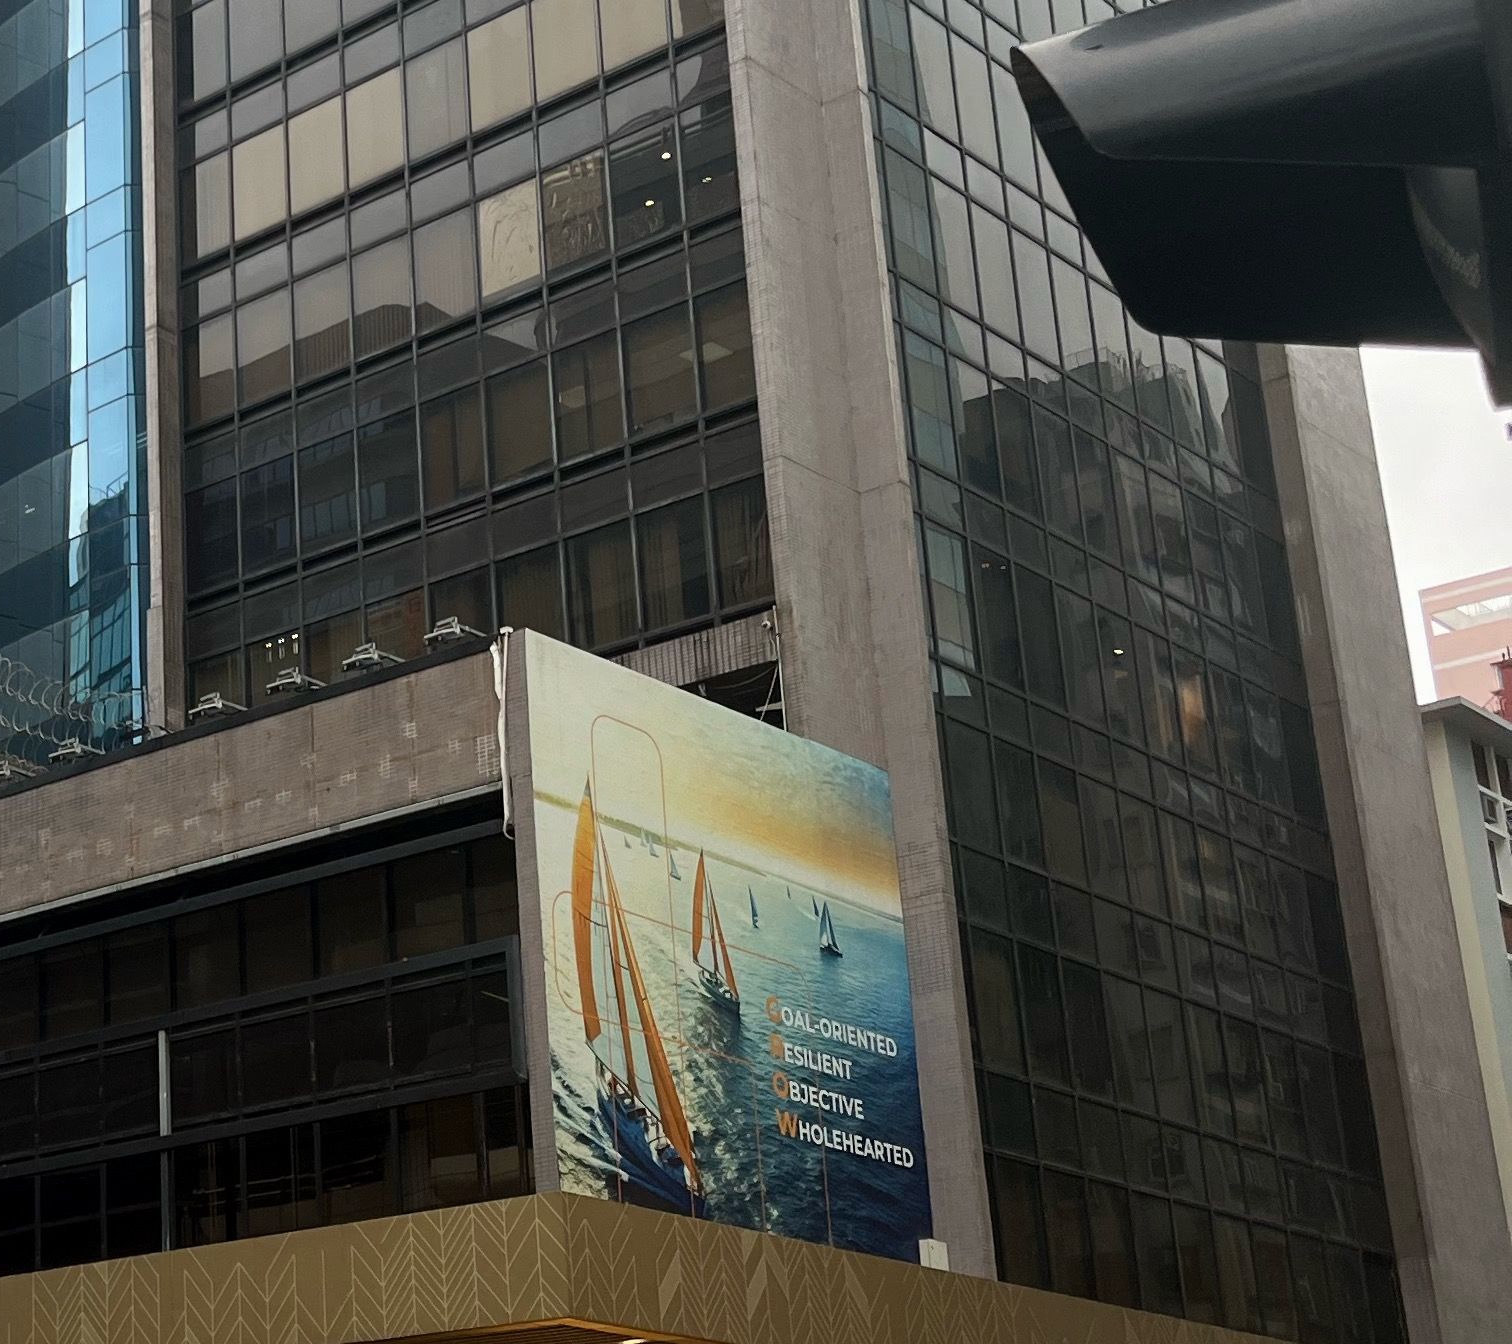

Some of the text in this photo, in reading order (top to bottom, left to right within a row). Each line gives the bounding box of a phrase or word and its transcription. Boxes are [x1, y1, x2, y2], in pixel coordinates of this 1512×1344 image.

[766, 995, 898, 1058] GOAL-ORIENTED
[769, 1032, 853, 1080] RESILIENT
[772, 1071, 865, 1120] OBJECTIVE
[775, 1108, 914, 1168] WHOLEHEARTED
